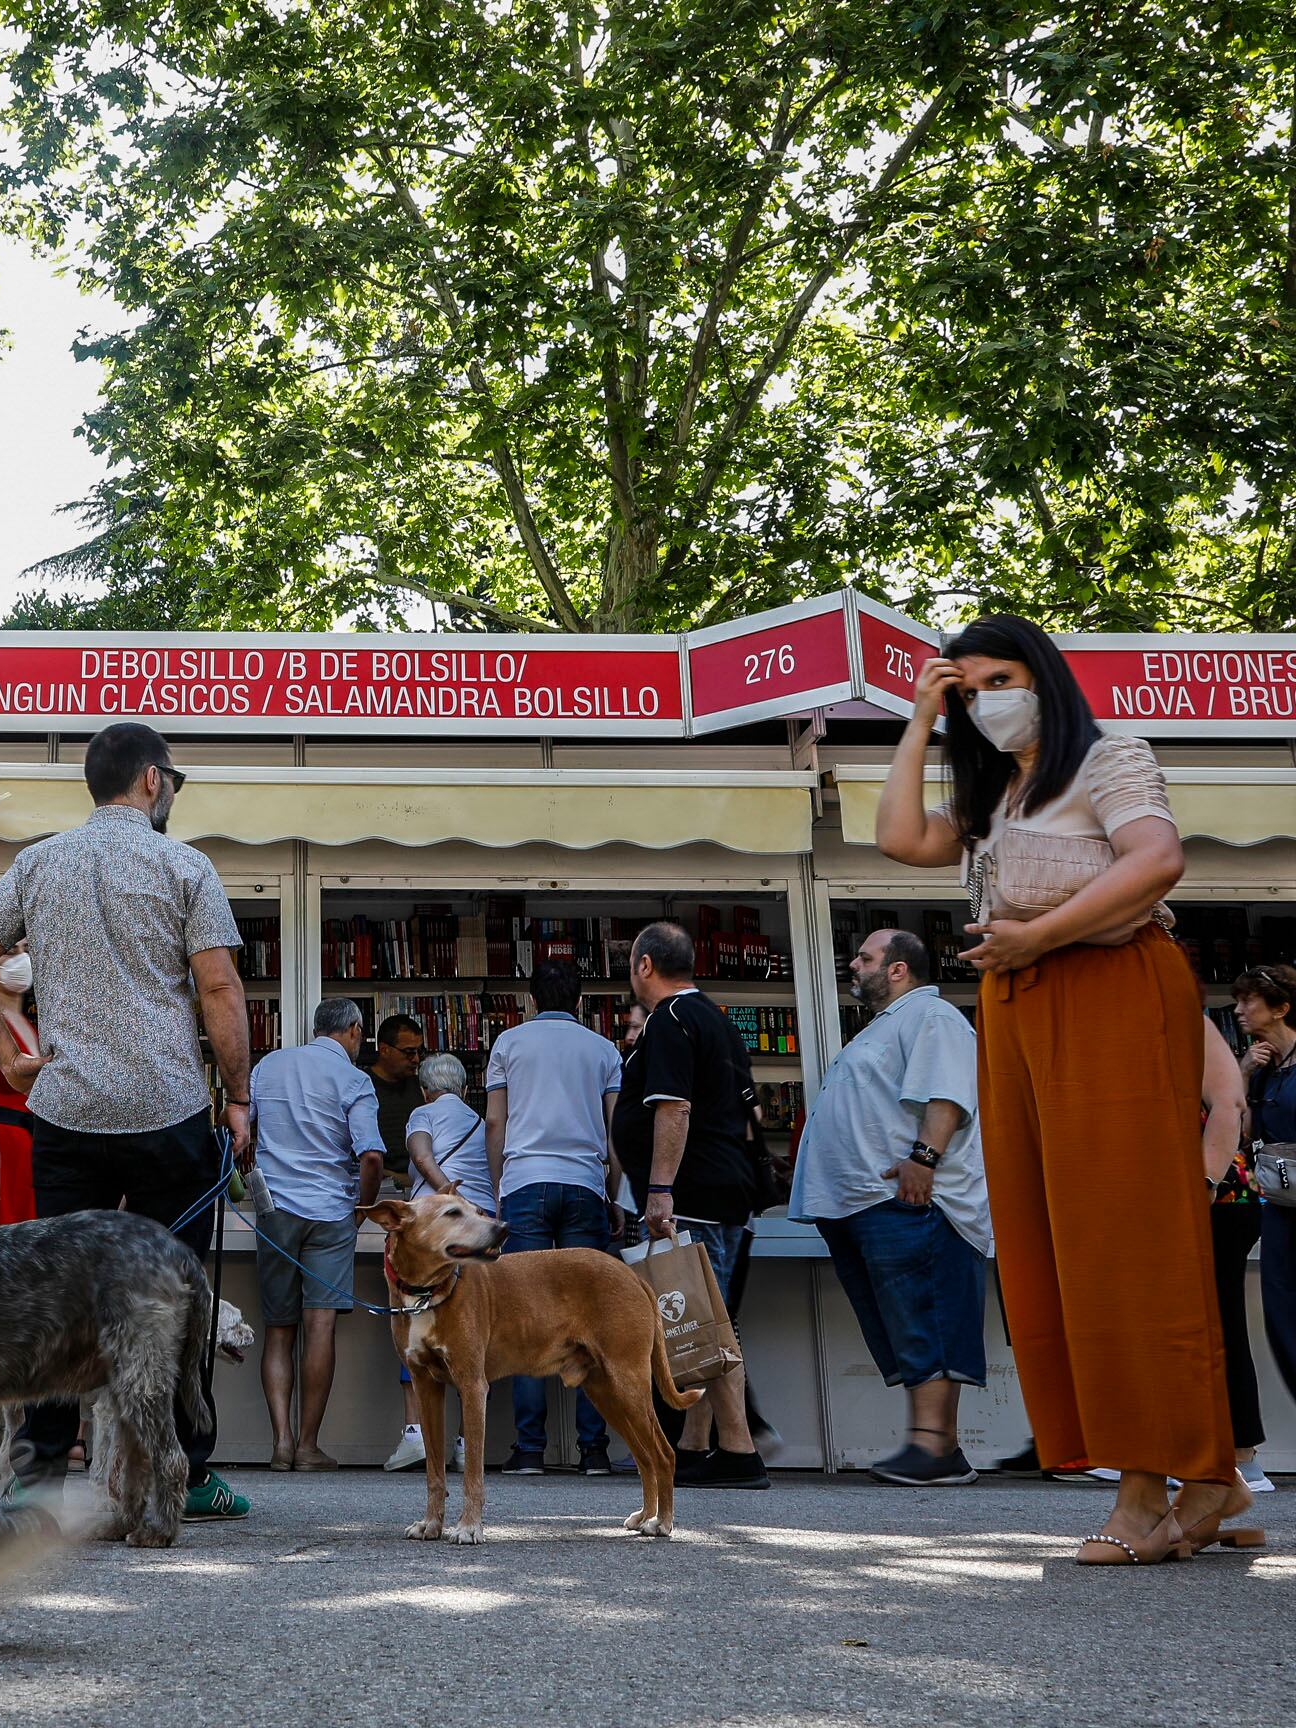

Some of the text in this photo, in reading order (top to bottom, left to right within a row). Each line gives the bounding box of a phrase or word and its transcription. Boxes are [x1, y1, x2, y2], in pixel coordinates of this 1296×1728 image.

[80, 649, 529, 683] DEBOLSILLO /B DE BOLSILLO/
[743, 643, 796, 685] 276
[884, 641, 915, 684] 275
[98, 677, 250, 715] CLÁSICOS
[261, 684, 274, 714] /
[285, 683, 503, 716] SALAMANDRA
[514, 686, 660, 717] BOLSILLO
[1111, 685, 1296, 716] NOVA / BRU
[745, 944, 768, 956] REINA
[745, 955, 769, 967] ROJA
